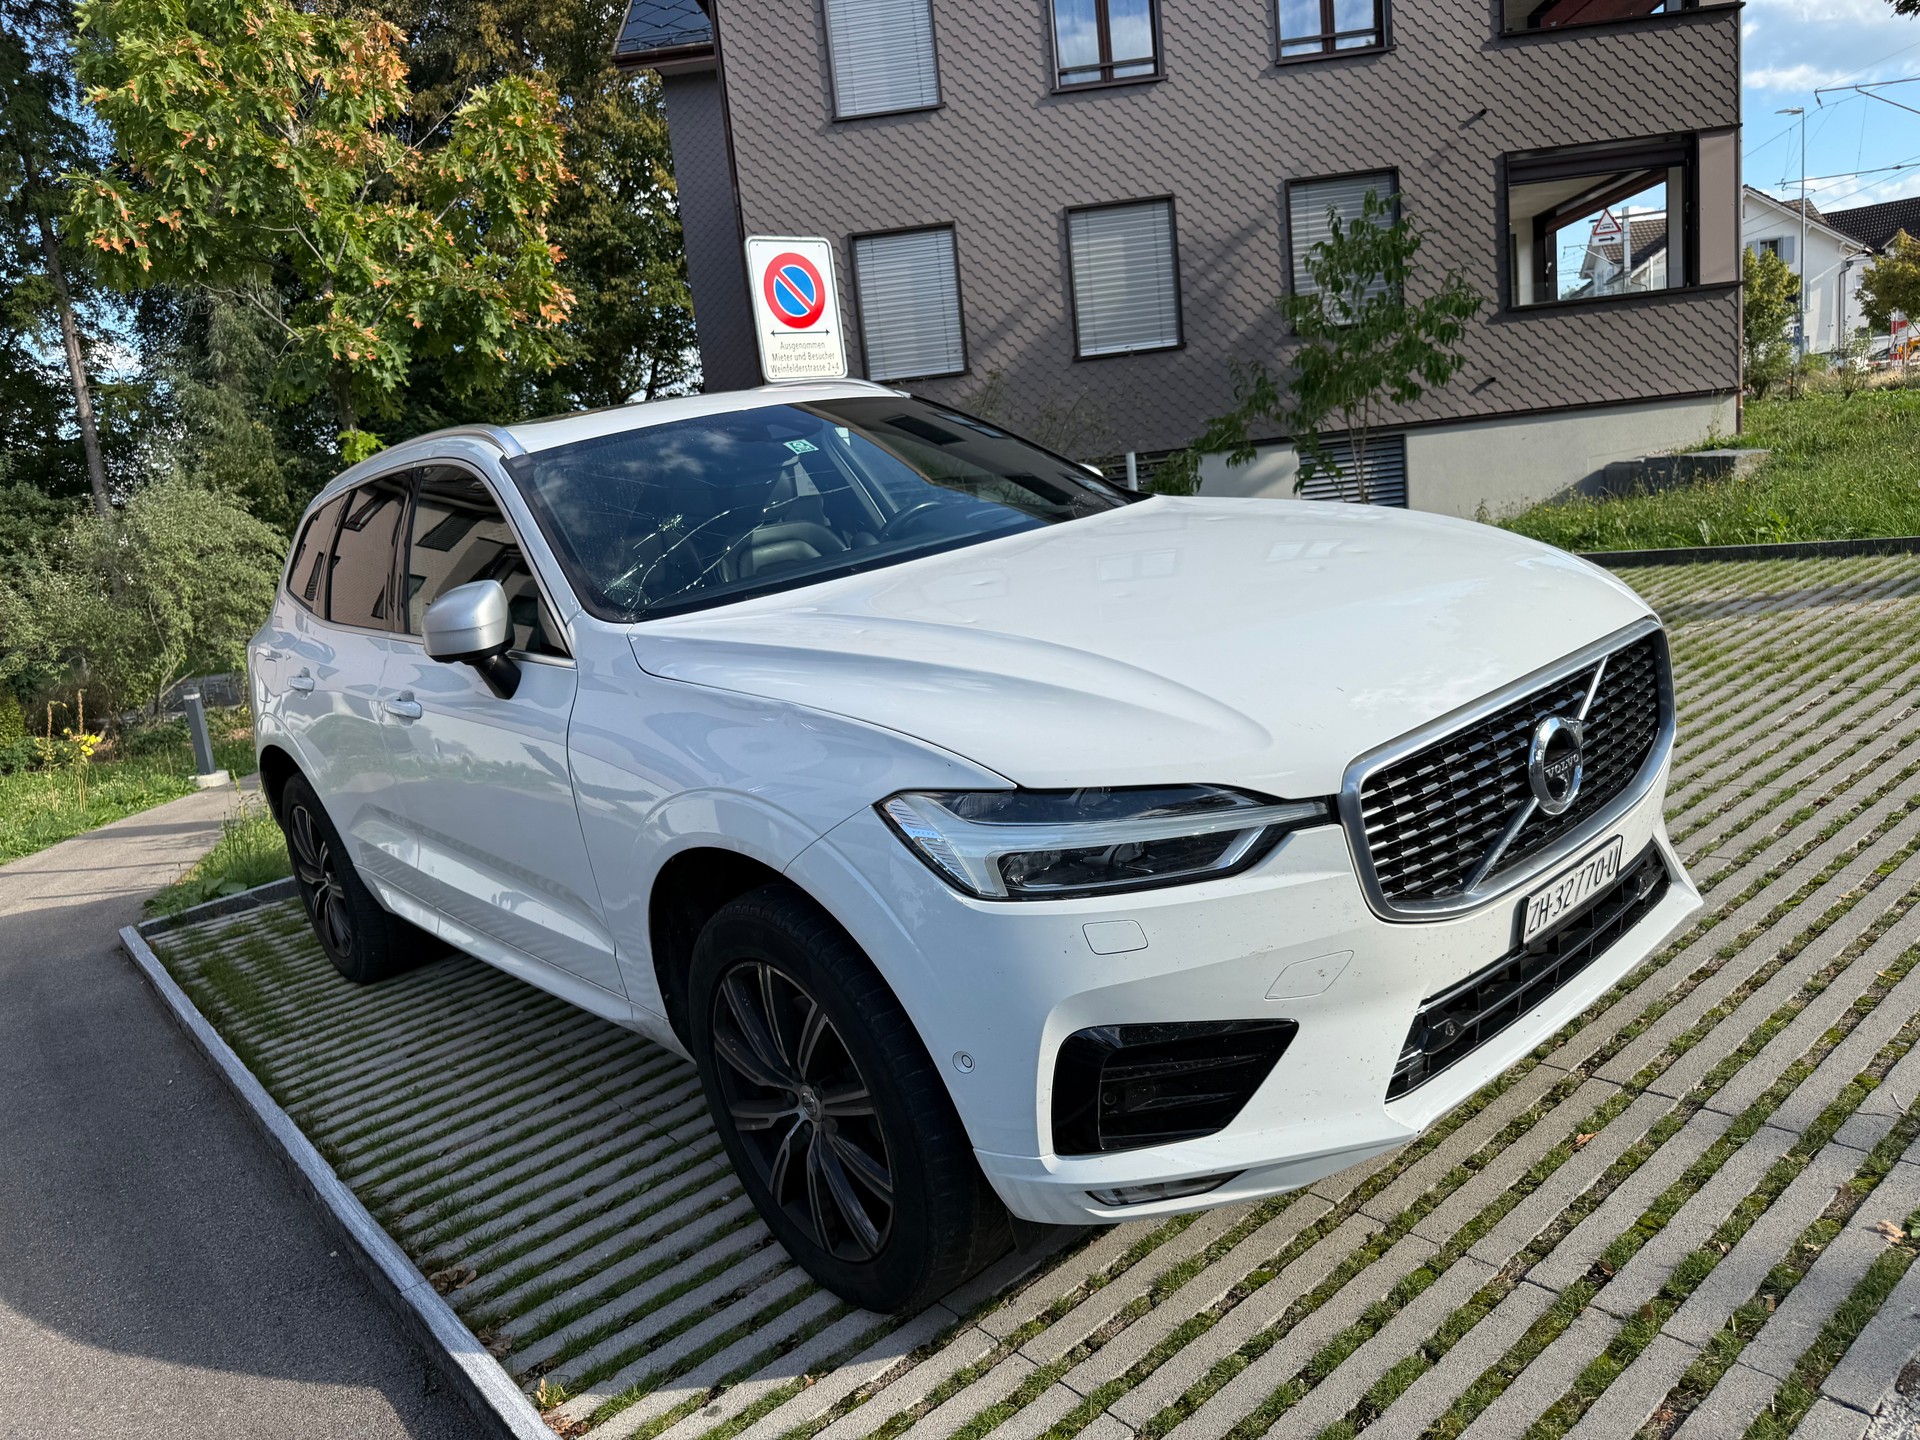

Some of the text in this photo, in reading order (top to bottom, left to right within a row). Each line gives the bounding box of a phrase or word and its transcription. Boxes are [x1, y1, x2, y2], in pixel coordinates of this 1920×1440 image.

[780, 341, 825, 352] Ausgenommen
[771, 350, 835, 361] Mieter und Besucher
[770, 364, 826, 373] Weinfelderstrasse
[1545, 753, 1580, 778] VOLVO
